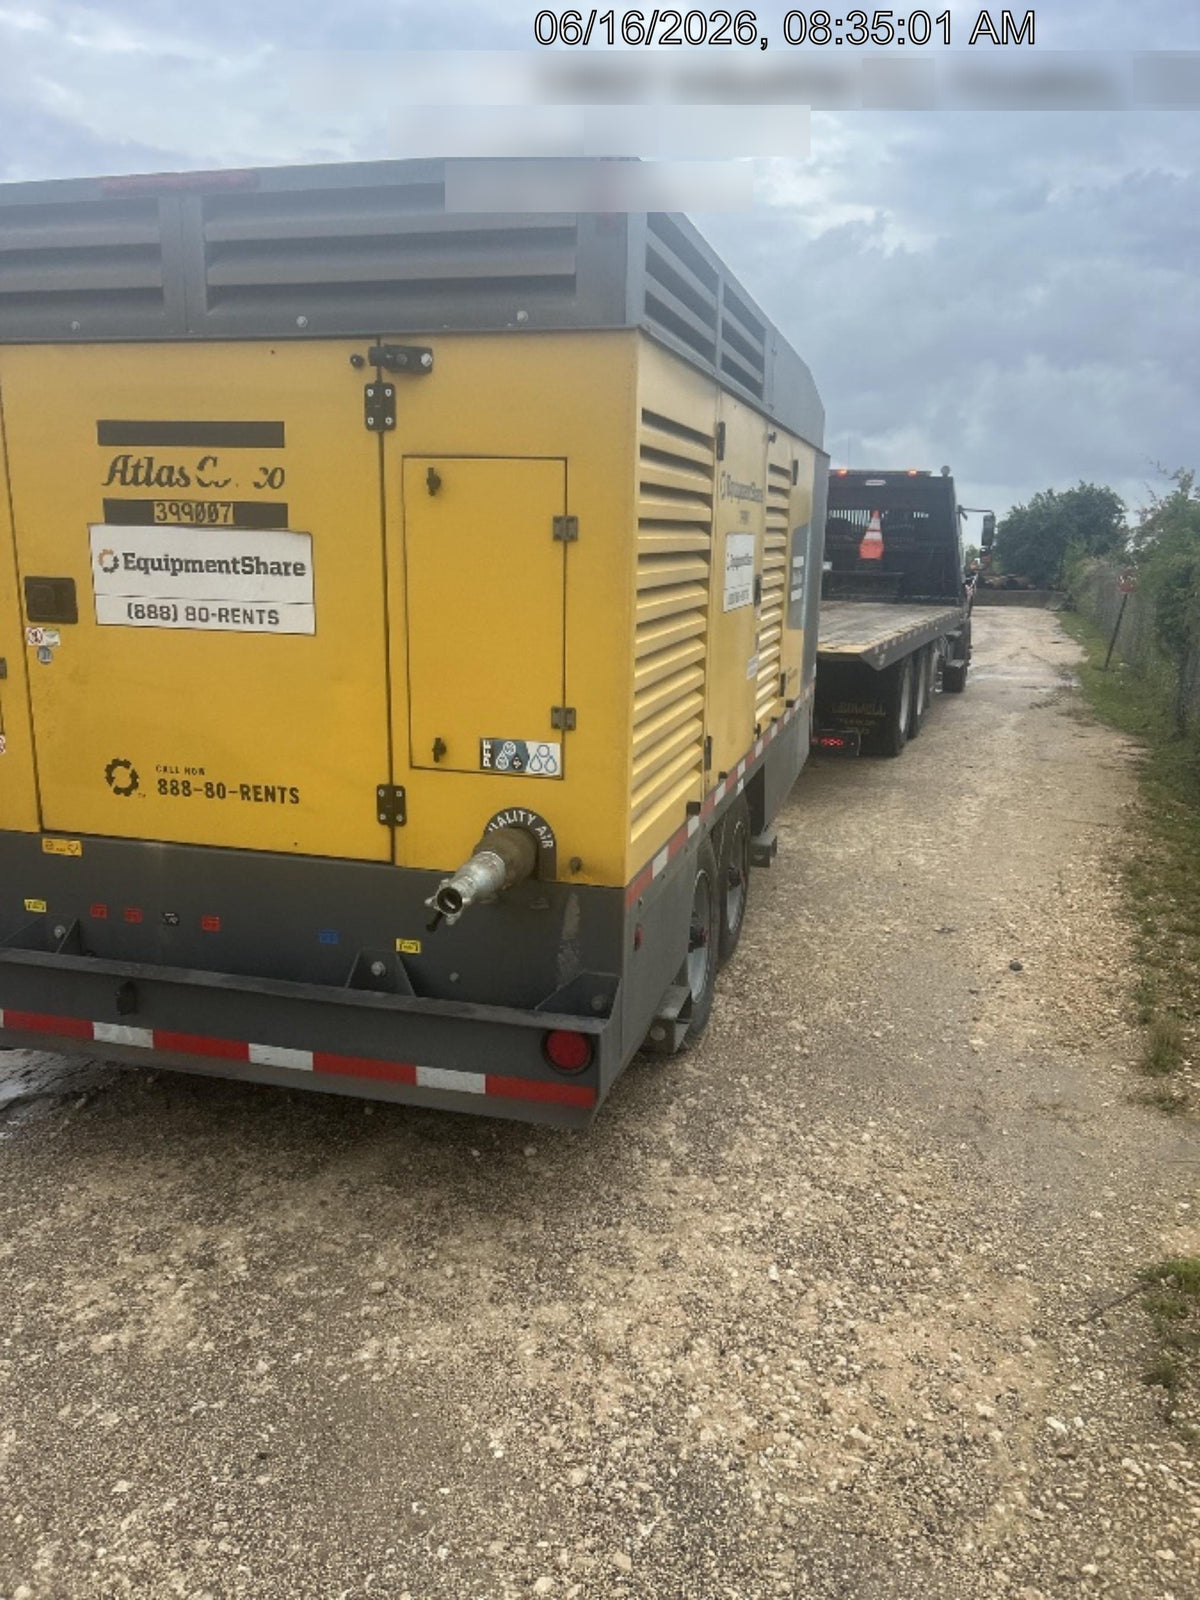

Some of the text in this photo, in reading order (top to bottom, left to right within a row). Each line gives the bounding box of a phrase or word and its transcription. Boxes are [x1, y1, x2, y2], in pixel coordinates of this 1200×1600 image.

[102, 455, 191, 488] Atlas
[156, 503, 232, 523] 399007
[122, 552, 306, 577] EquipmentShare
[127, 602, 280, 625] (888) 80-RENTS
[155, 765, 180, 774] CALL
[157, 778, 300, 804] 888-80-RENTS
[488, 810, 536, 831] UALITY
